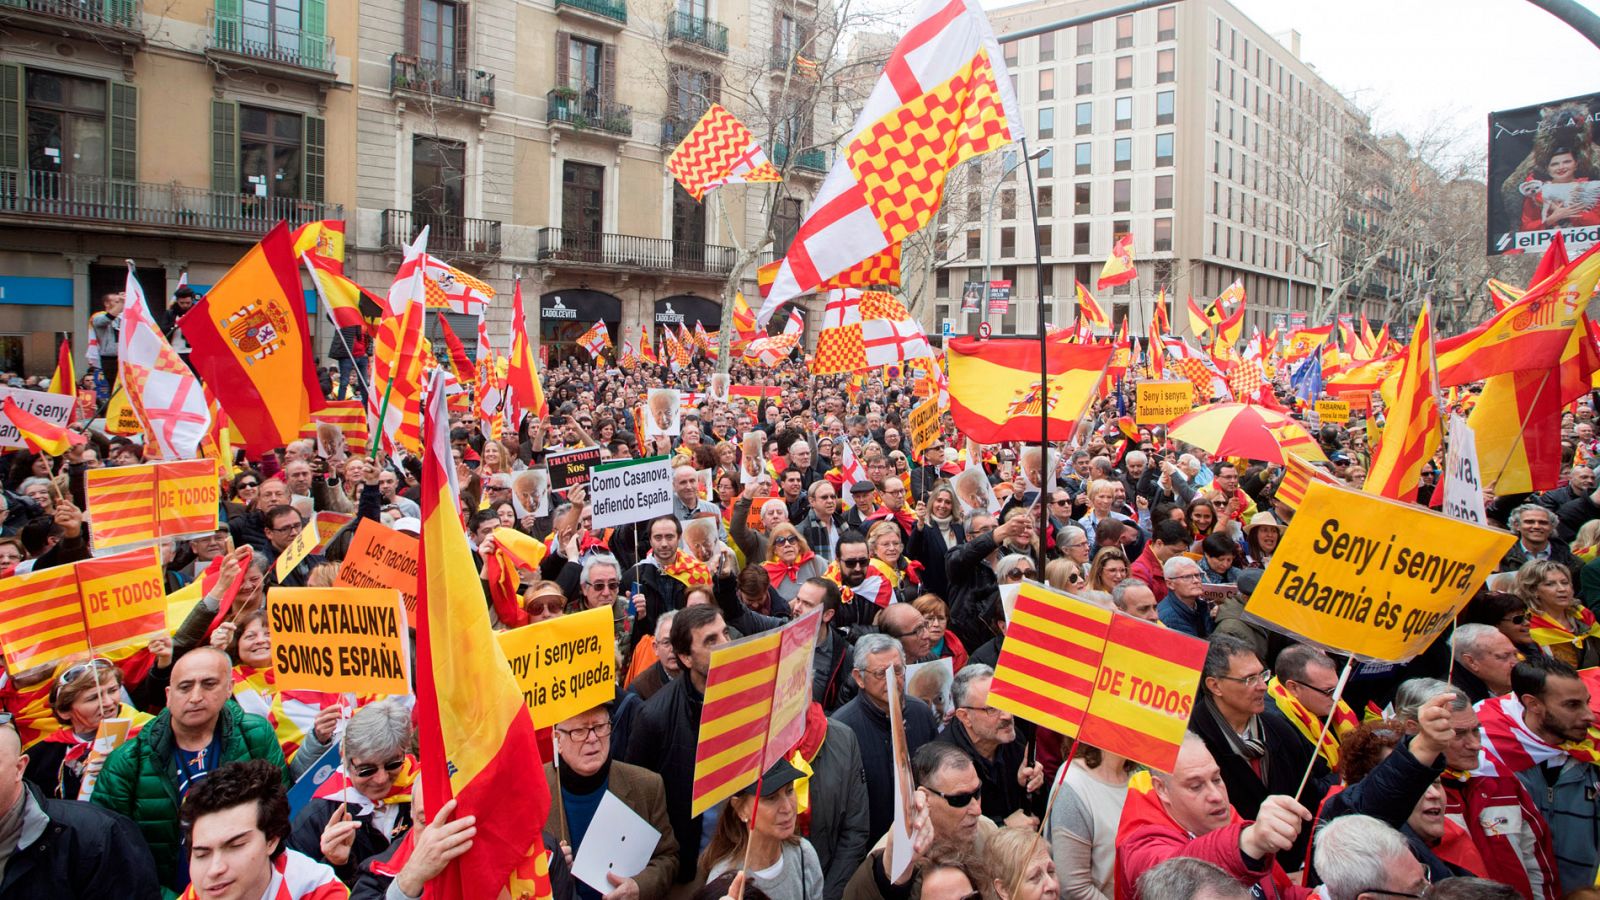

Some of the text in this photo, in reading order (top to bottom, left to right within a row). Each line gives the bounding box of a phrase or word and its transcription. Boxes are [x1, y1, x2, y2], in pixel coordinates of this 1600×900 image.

[1139, 405, 1165, 416] Tabarnia
[1143, 390, 1160, 403] Seny
[549, 450, 600, 466] TRACTORIA
[160, 486, 217, 508] DE TODOS
[592, 467, 670, 492] Como Casanova,
[593, 488, 671, 516] defiendo España.
[365, 535, 386, 562] Los
[1313, 518, 1477, 596] Seny i senyra,
[89, 578, 162, 614] DE TODOS
[1273, 561, 1374, 624] Tabarnia
[1373, 591, 1403, 630] ès
[272, 603, 398, 638] SOM CATALUNYA
[276, 642, 404, 679] SOMOS ESPAÑA
[535, 644, 540, 669] i
[544, 634, 602, 667] senyera,
[551, 676, 566, 701] ès
[570, 661, 613, 699] queda.
[1097, 666, 1192, 720] DE TODOS
